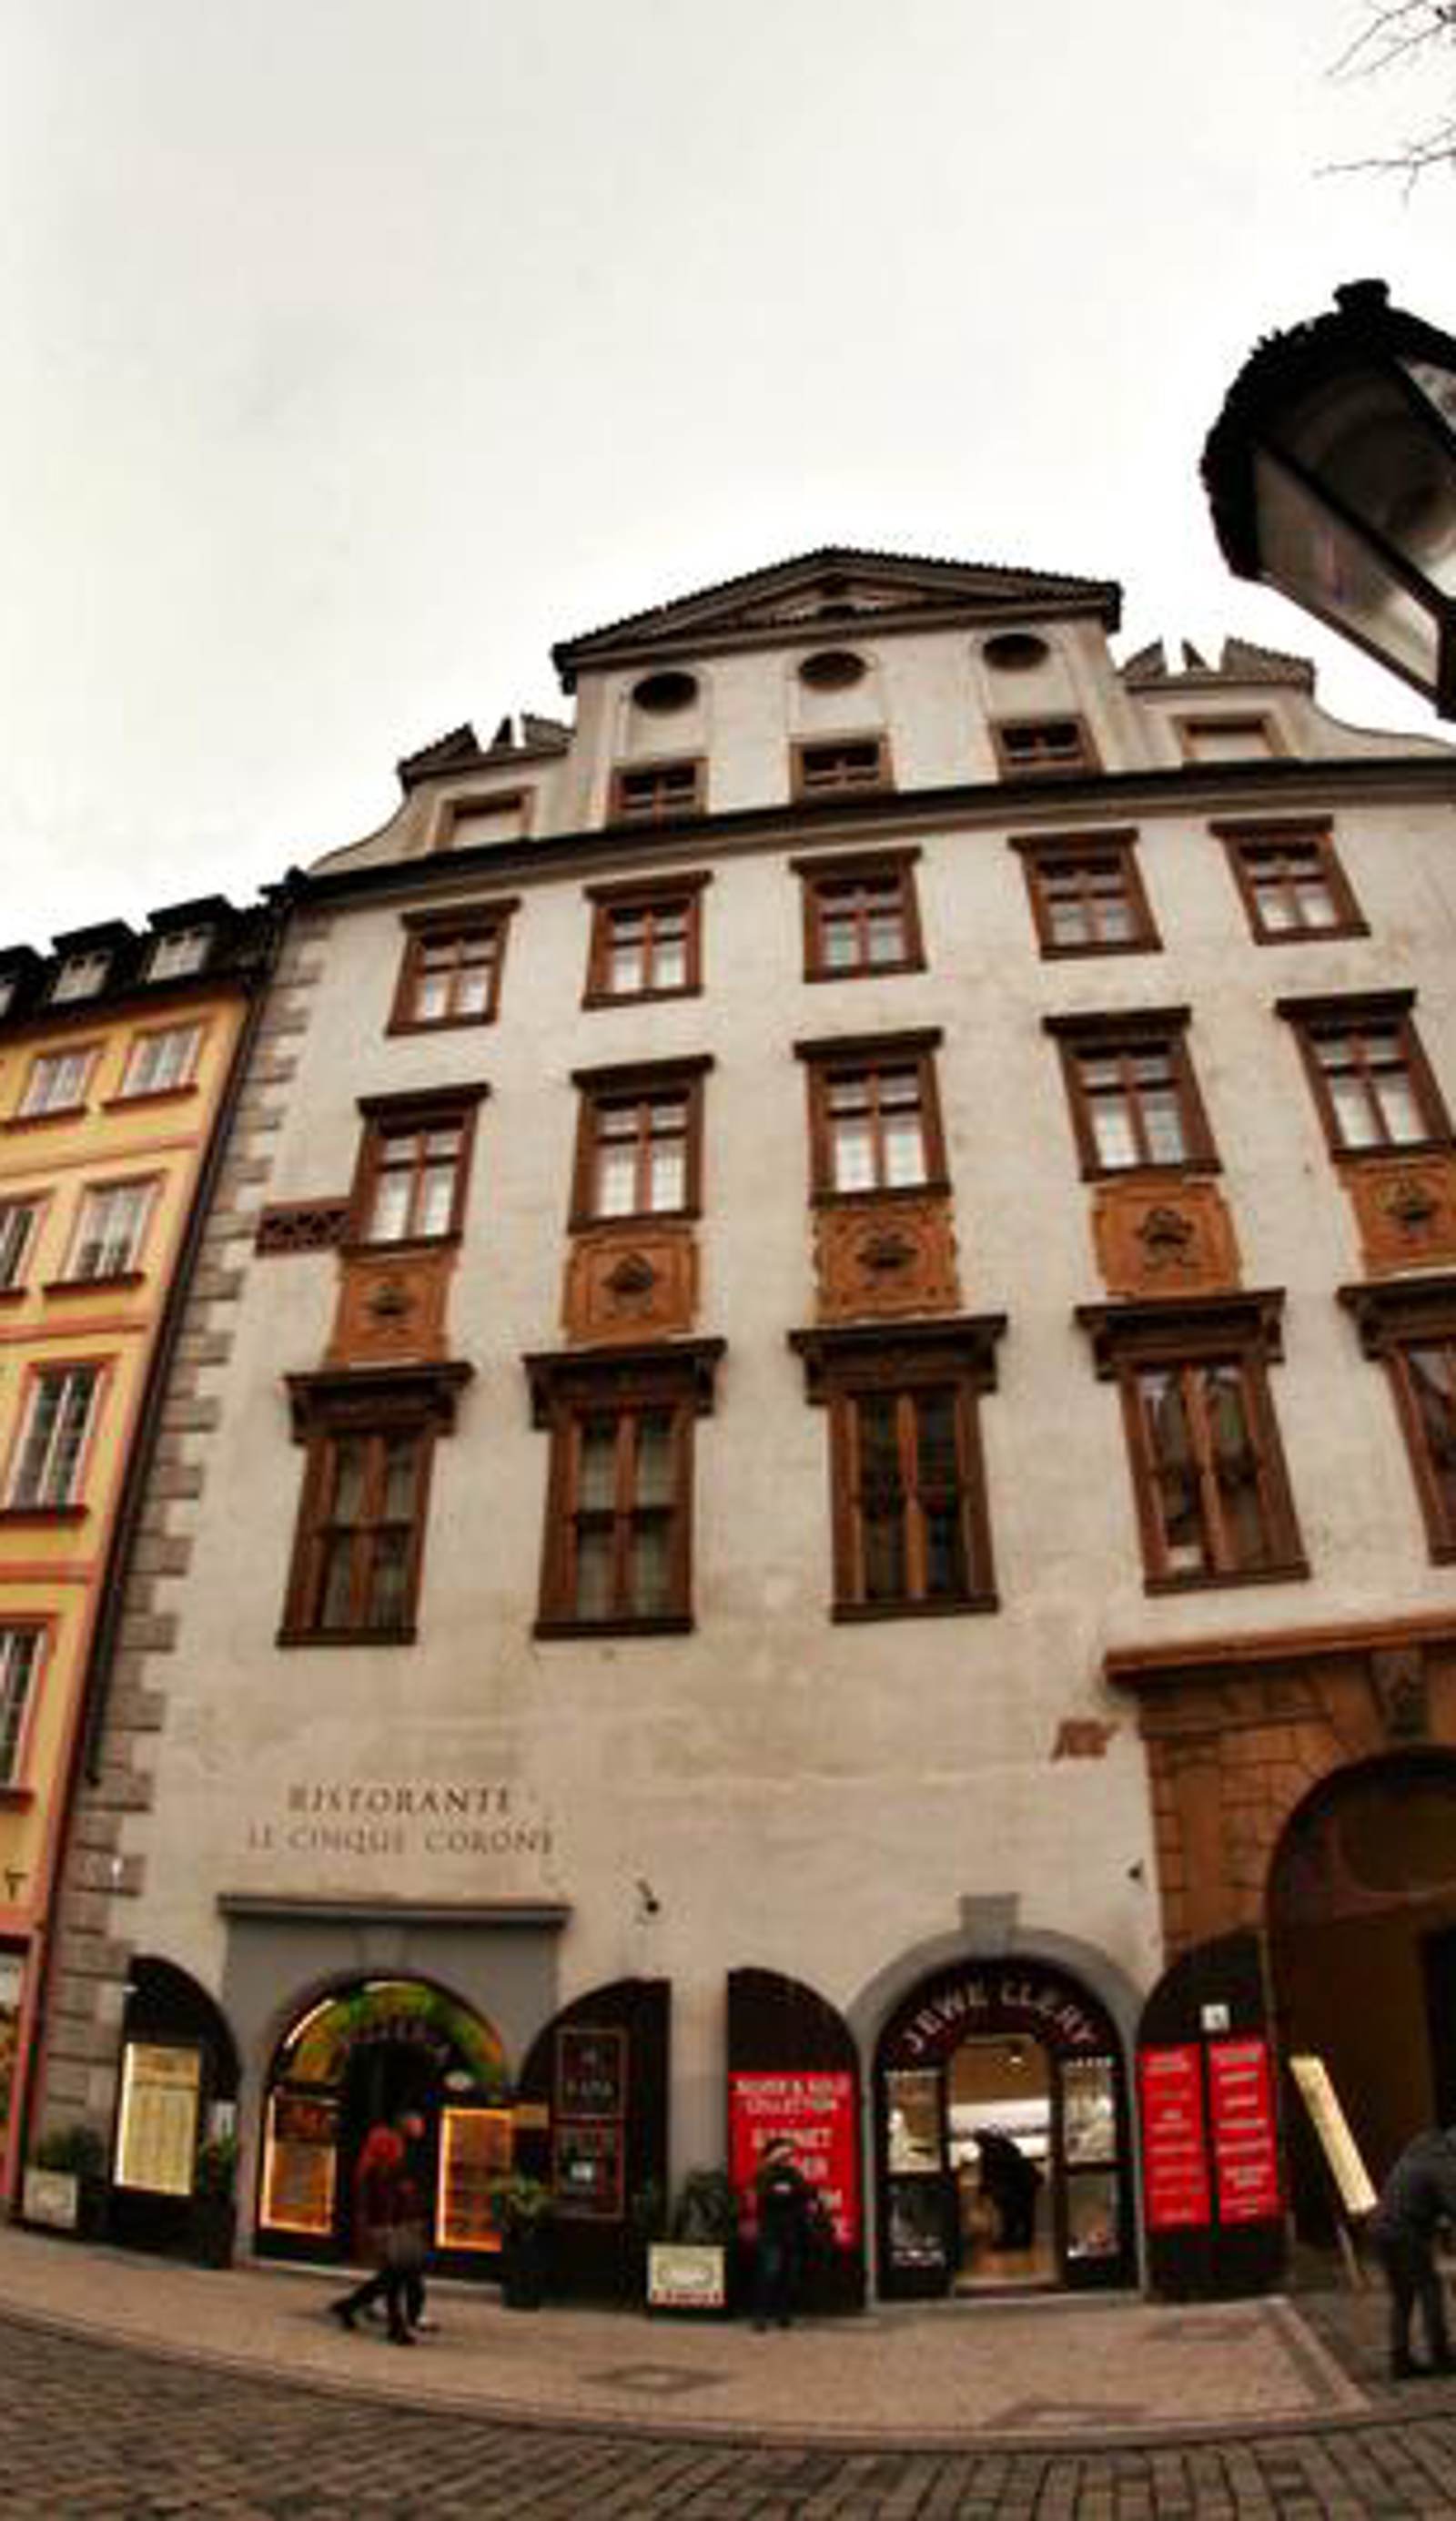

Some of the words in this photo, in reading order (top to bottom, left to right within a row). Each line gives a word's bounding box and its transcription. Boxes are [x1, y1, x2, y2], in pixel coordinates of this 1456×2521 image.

[287, 1784, 511, 1815] RISTORANTE
[287, 1825, 406, 1855] CINQUE
[424, 1825, 554, 1856] CORONE
